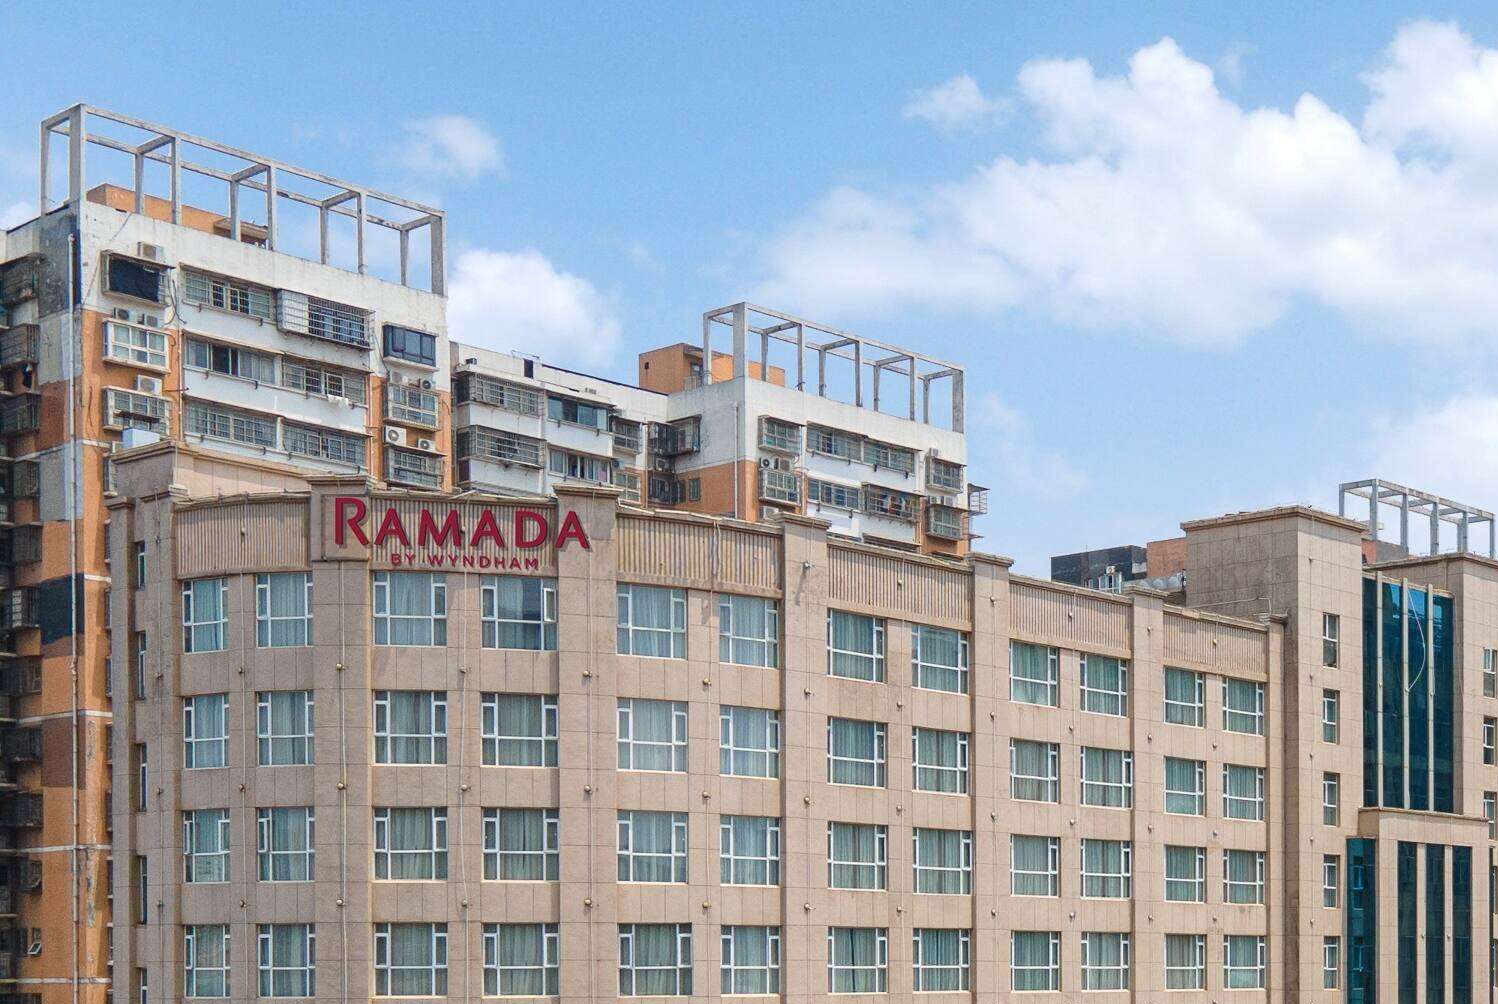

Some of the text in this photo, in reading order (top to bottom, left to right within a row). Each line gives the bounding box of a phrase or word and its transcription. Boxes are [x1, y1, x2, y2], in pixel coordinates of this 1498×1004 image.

[334, 496, 591, 549] RAMADA
[391, 553, 539, 570] BY WYNDHAM
